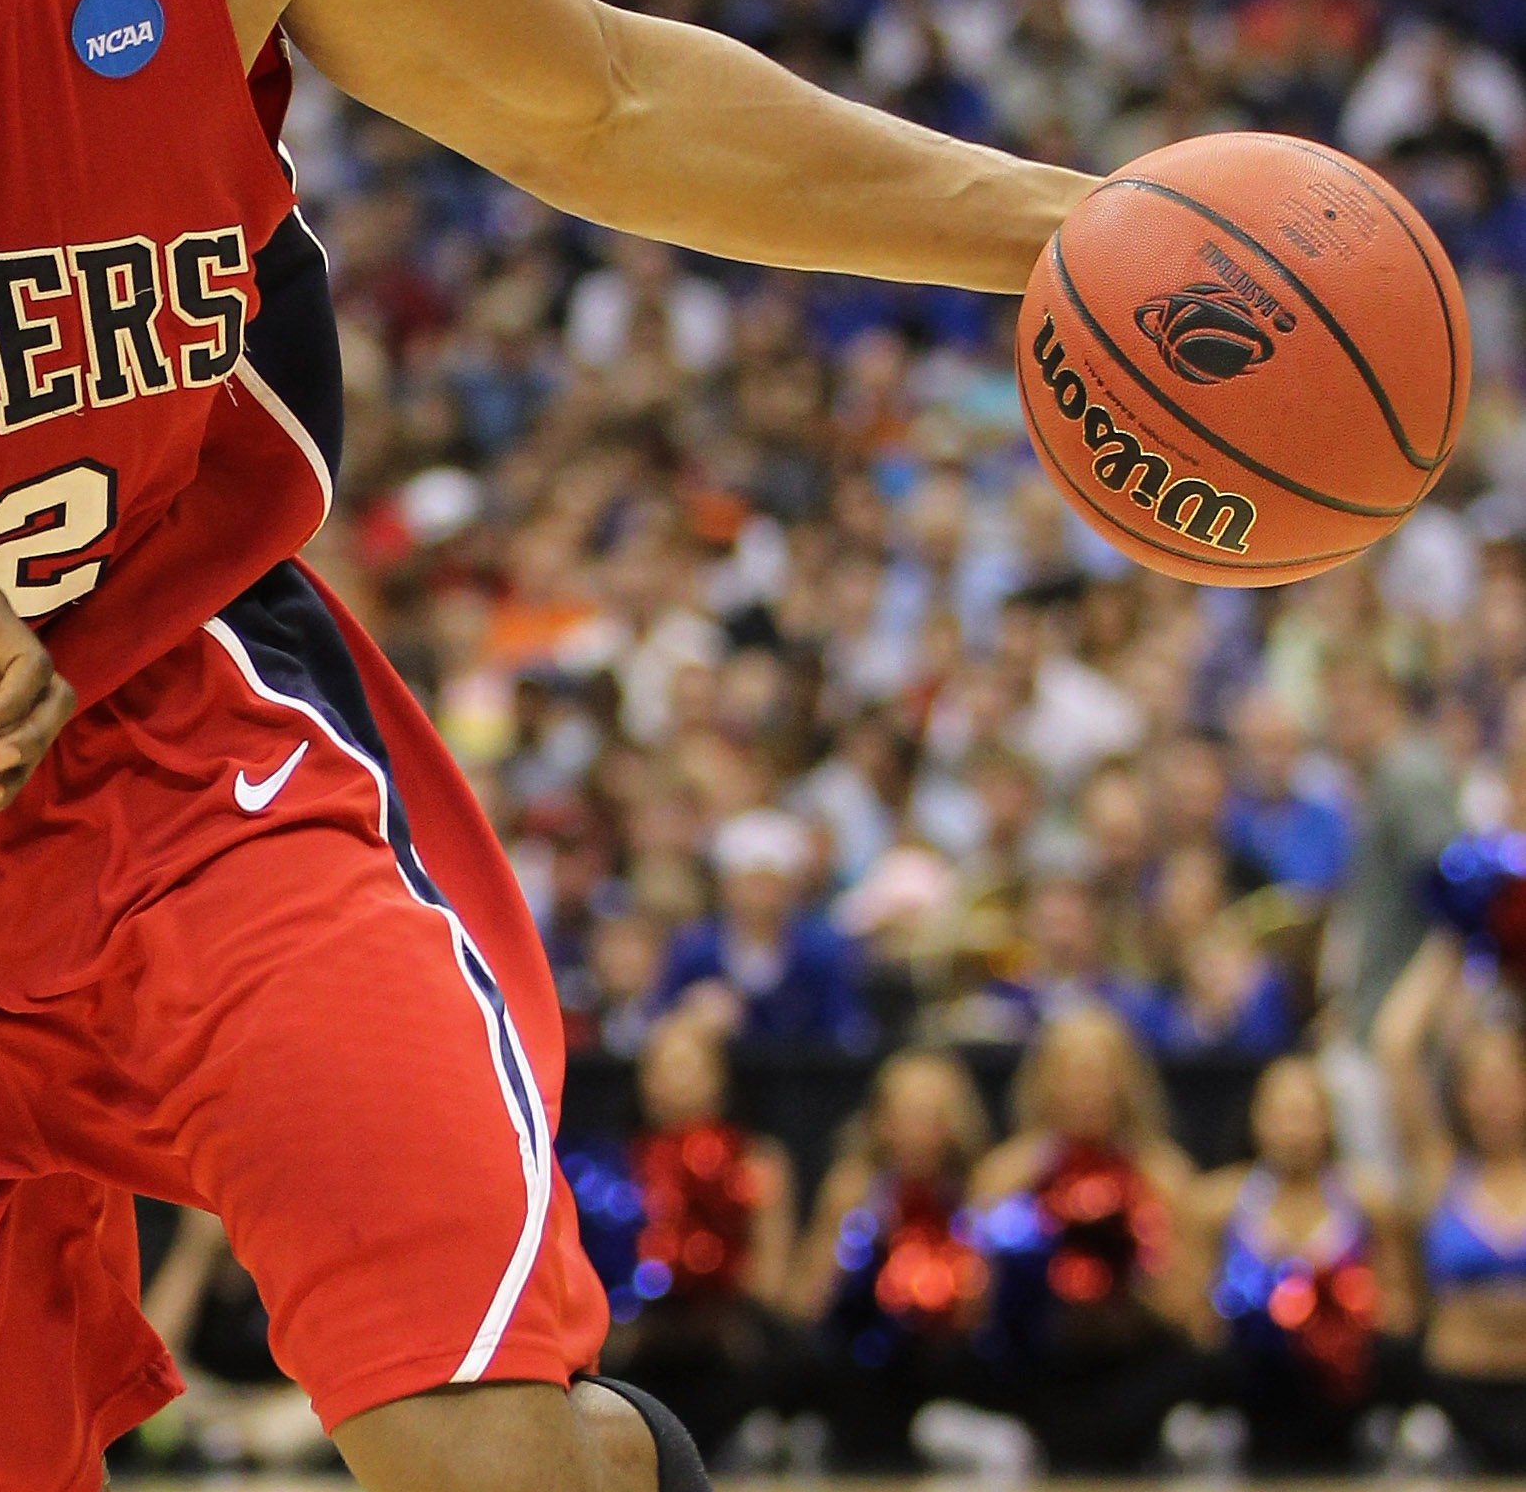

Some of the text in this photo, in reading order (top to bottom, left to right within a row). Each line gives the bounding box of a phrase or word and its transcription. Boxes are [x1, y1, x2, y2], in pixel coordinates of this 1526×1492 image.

[86, 20, 154, 61] NCAA
[1197, 240, 1279, 317] BASKETBALL
[1032, 311, 1257, 555] Wilson
